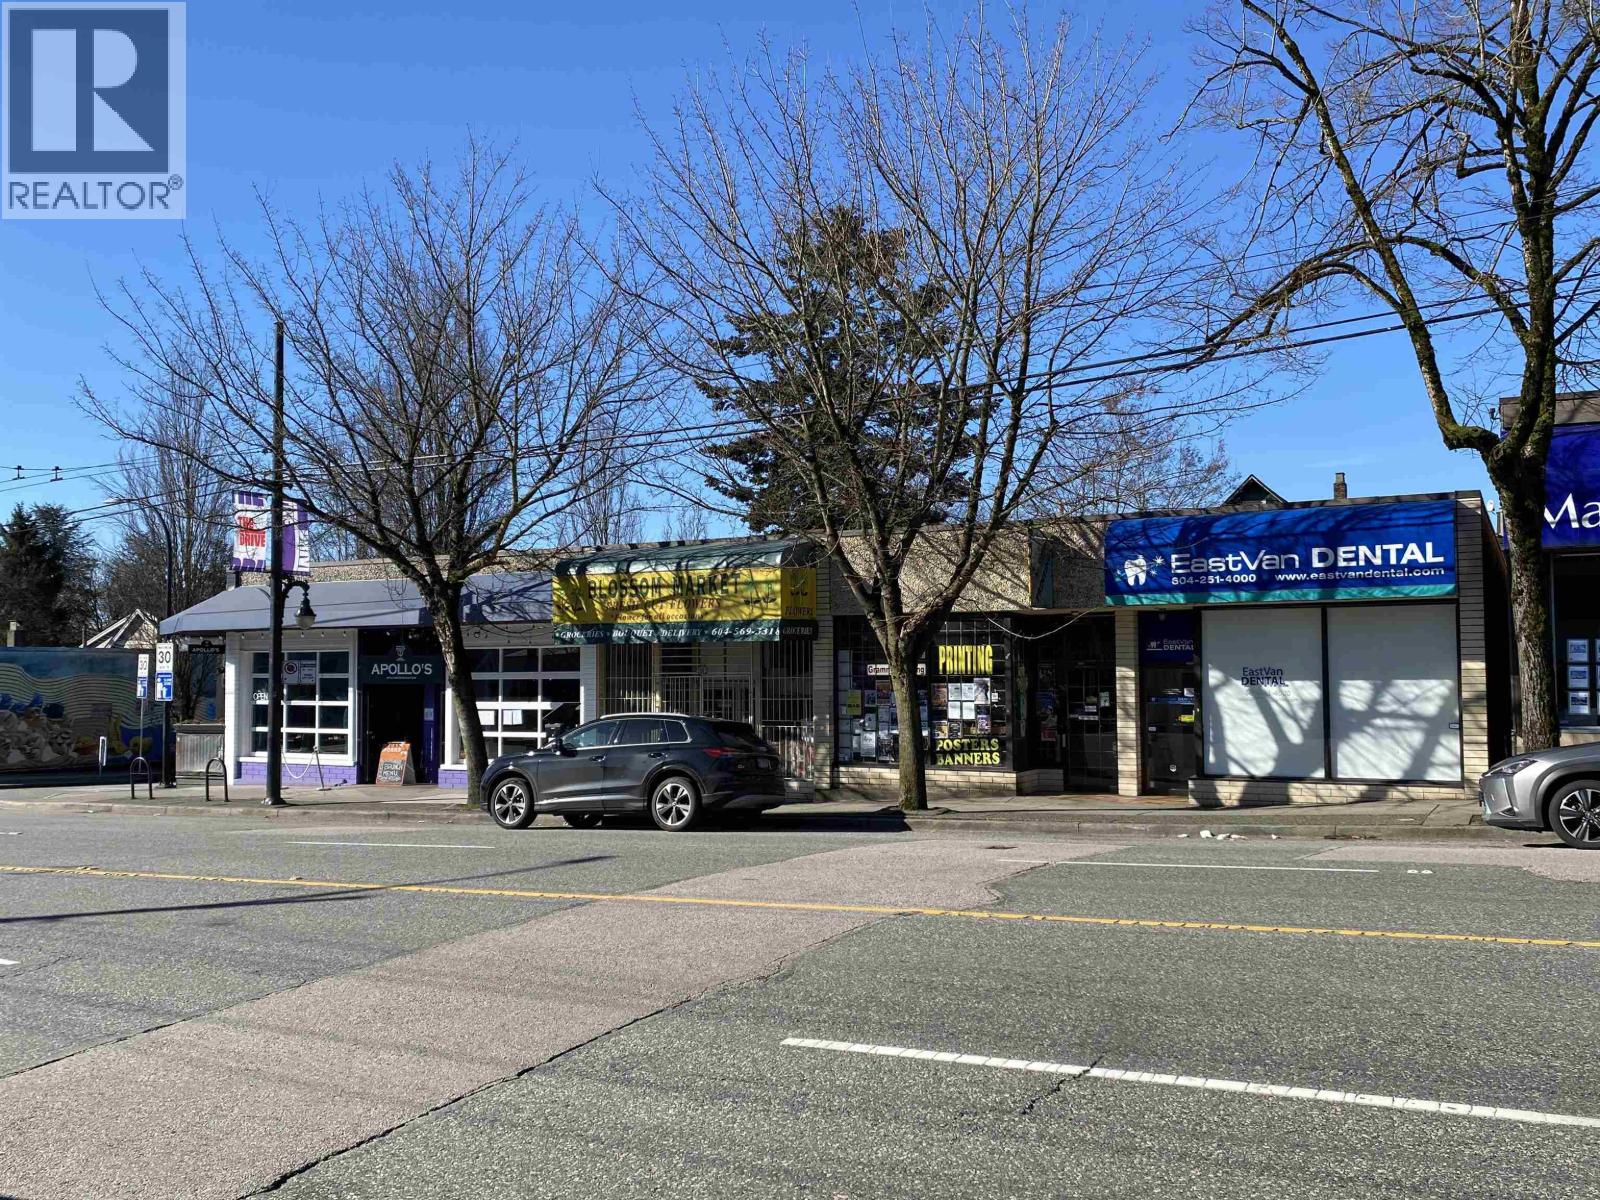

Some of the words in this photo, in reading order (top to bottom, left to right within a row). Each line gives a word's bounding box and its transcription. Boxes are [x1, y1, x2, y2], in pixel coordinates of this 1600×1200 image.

[240, 530, 266, 547] DRIVE
[1171, 550, 1299, 574] EastVan
[1312, 542, 1445, 567] DENTAL
[1172, 574, 1257, 585] 604-251-4000
[1275, 567, 1445, 582] www.eastvandental.com
[588, 577, 662, 600] BLOSSOM
[673, 573, 741, 597] MARKET
[158, 651, 171, 664] 30
[938, 644, 993, 675] PRINTING
[139, 661, 147, 671] 30
[371, 663, 433, 675] APOLLO'S
[1242, 667, 1284, 677] EastVan
[1241, 676, 1286, 686] DENTAL
[935, 738, 999, 751] POSTERS
[935, 752, 1000, 766] BANNERS
